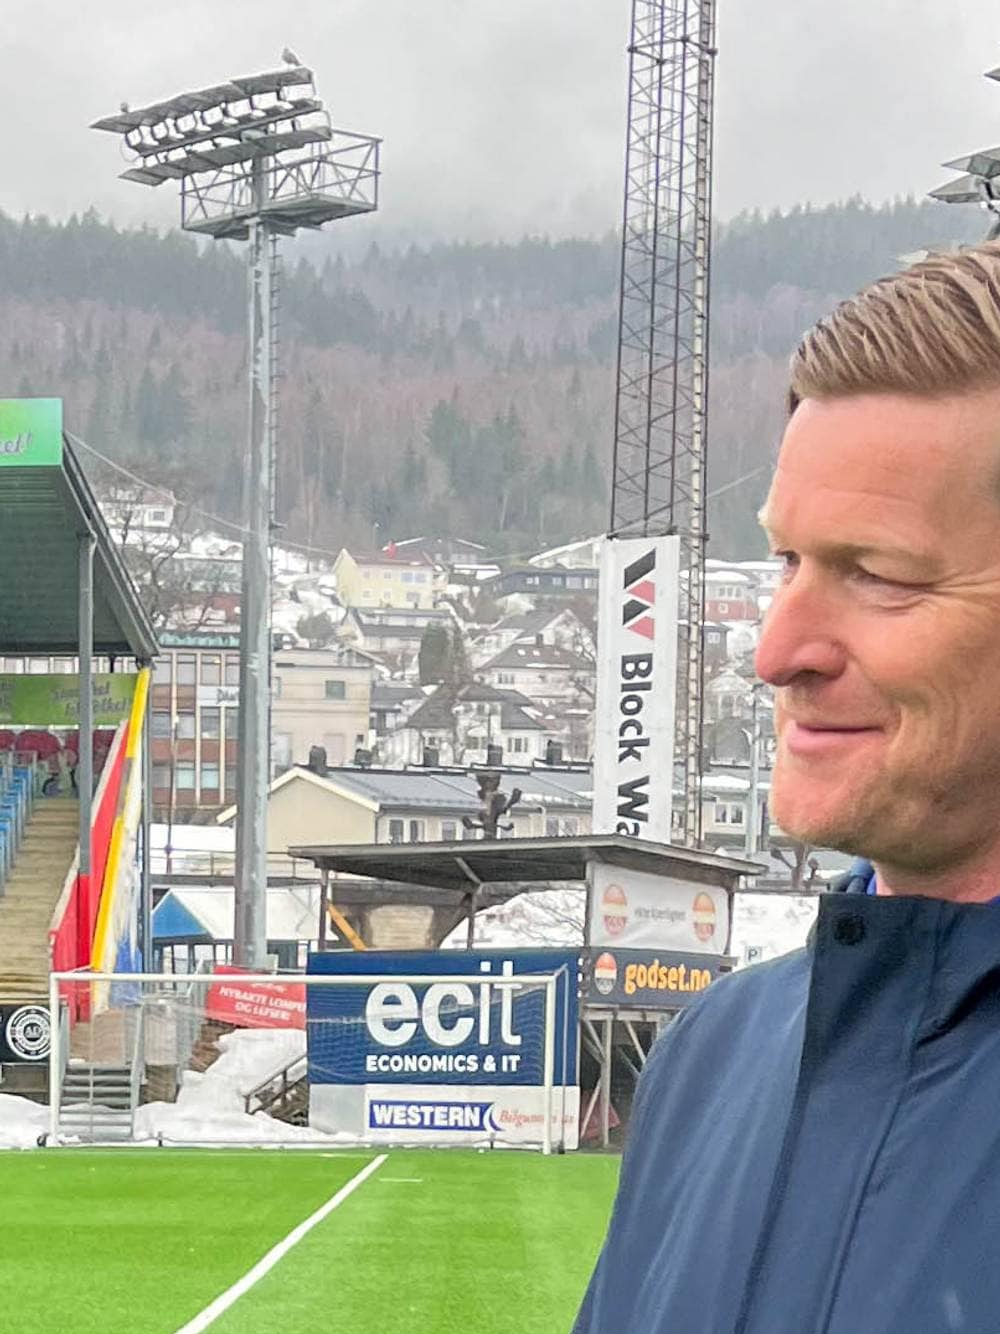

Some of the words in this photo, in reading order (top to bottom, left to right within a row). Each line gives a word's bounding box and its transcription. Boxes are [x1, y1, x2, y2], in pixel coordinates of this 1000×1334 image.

[619, 653, 653, 763] Block
[624, 959, 712, 994] godset.no
[235, 1001, 252, 1014] OG
[365, 961, 522, 1046] ecit
[366, 1055, 478, 1072] ECONOMICS
[483, 1055, 496, 1072] &
[502, 1055, 521, 1072] IT
[373, 1104, 480, 1127] WESTERN
